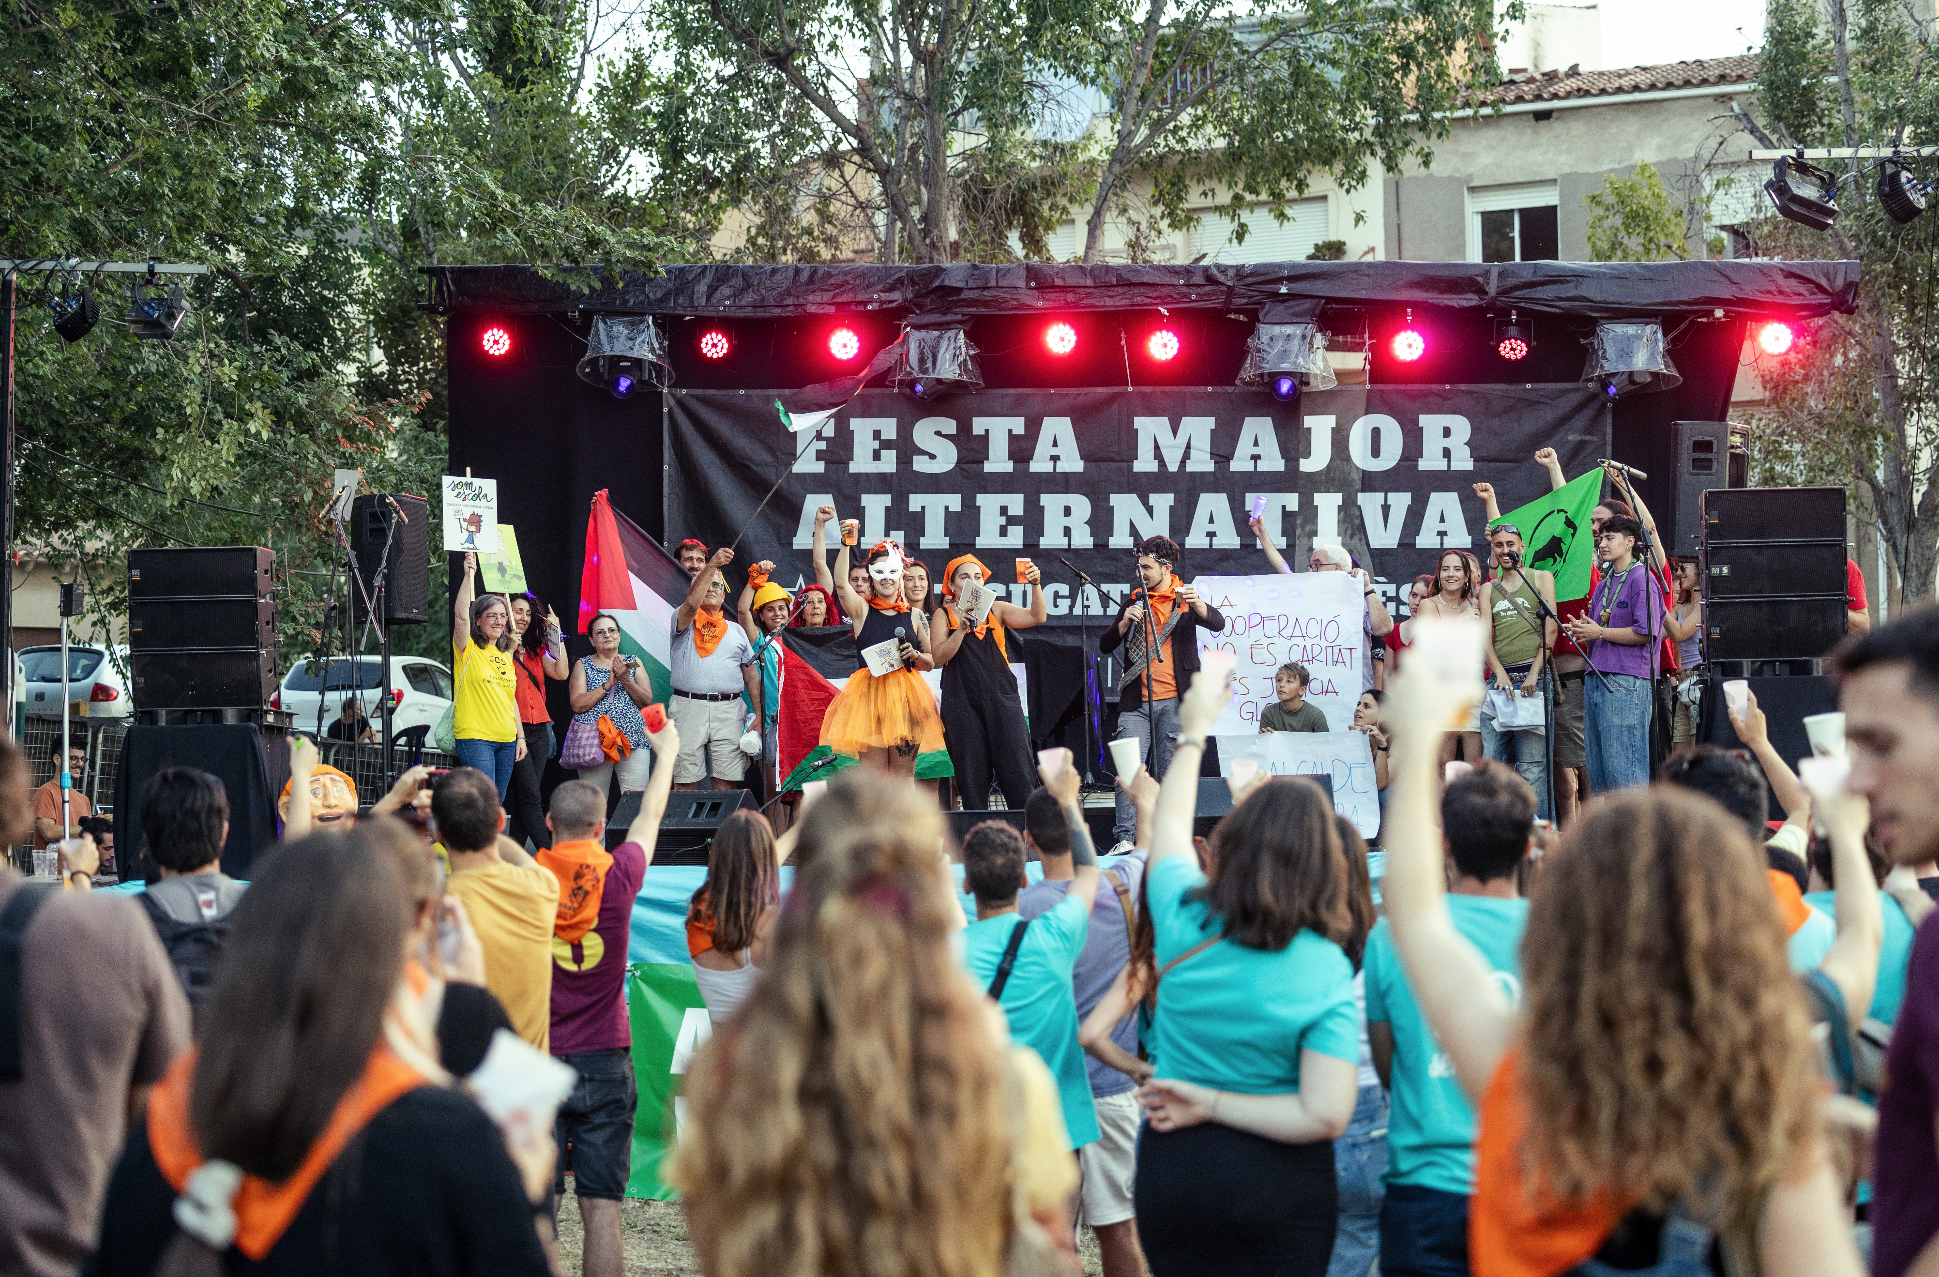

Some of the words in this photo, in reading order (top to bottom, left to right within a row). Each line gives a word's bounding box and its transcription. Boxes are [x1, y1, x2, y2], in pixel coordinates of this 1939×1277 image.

[791, 416, 1085, 474] FESTA
[1132, 413, 1474, 473] MAJOR
[446, 480, 477, 492] som
[453, 485, 494, 503] escola
[792, 491, 1472, 549] ALTERNATIVA
[1249, 638, 1277, 667] ÉS
[1288, 643, 1358, 670] CARITAT
